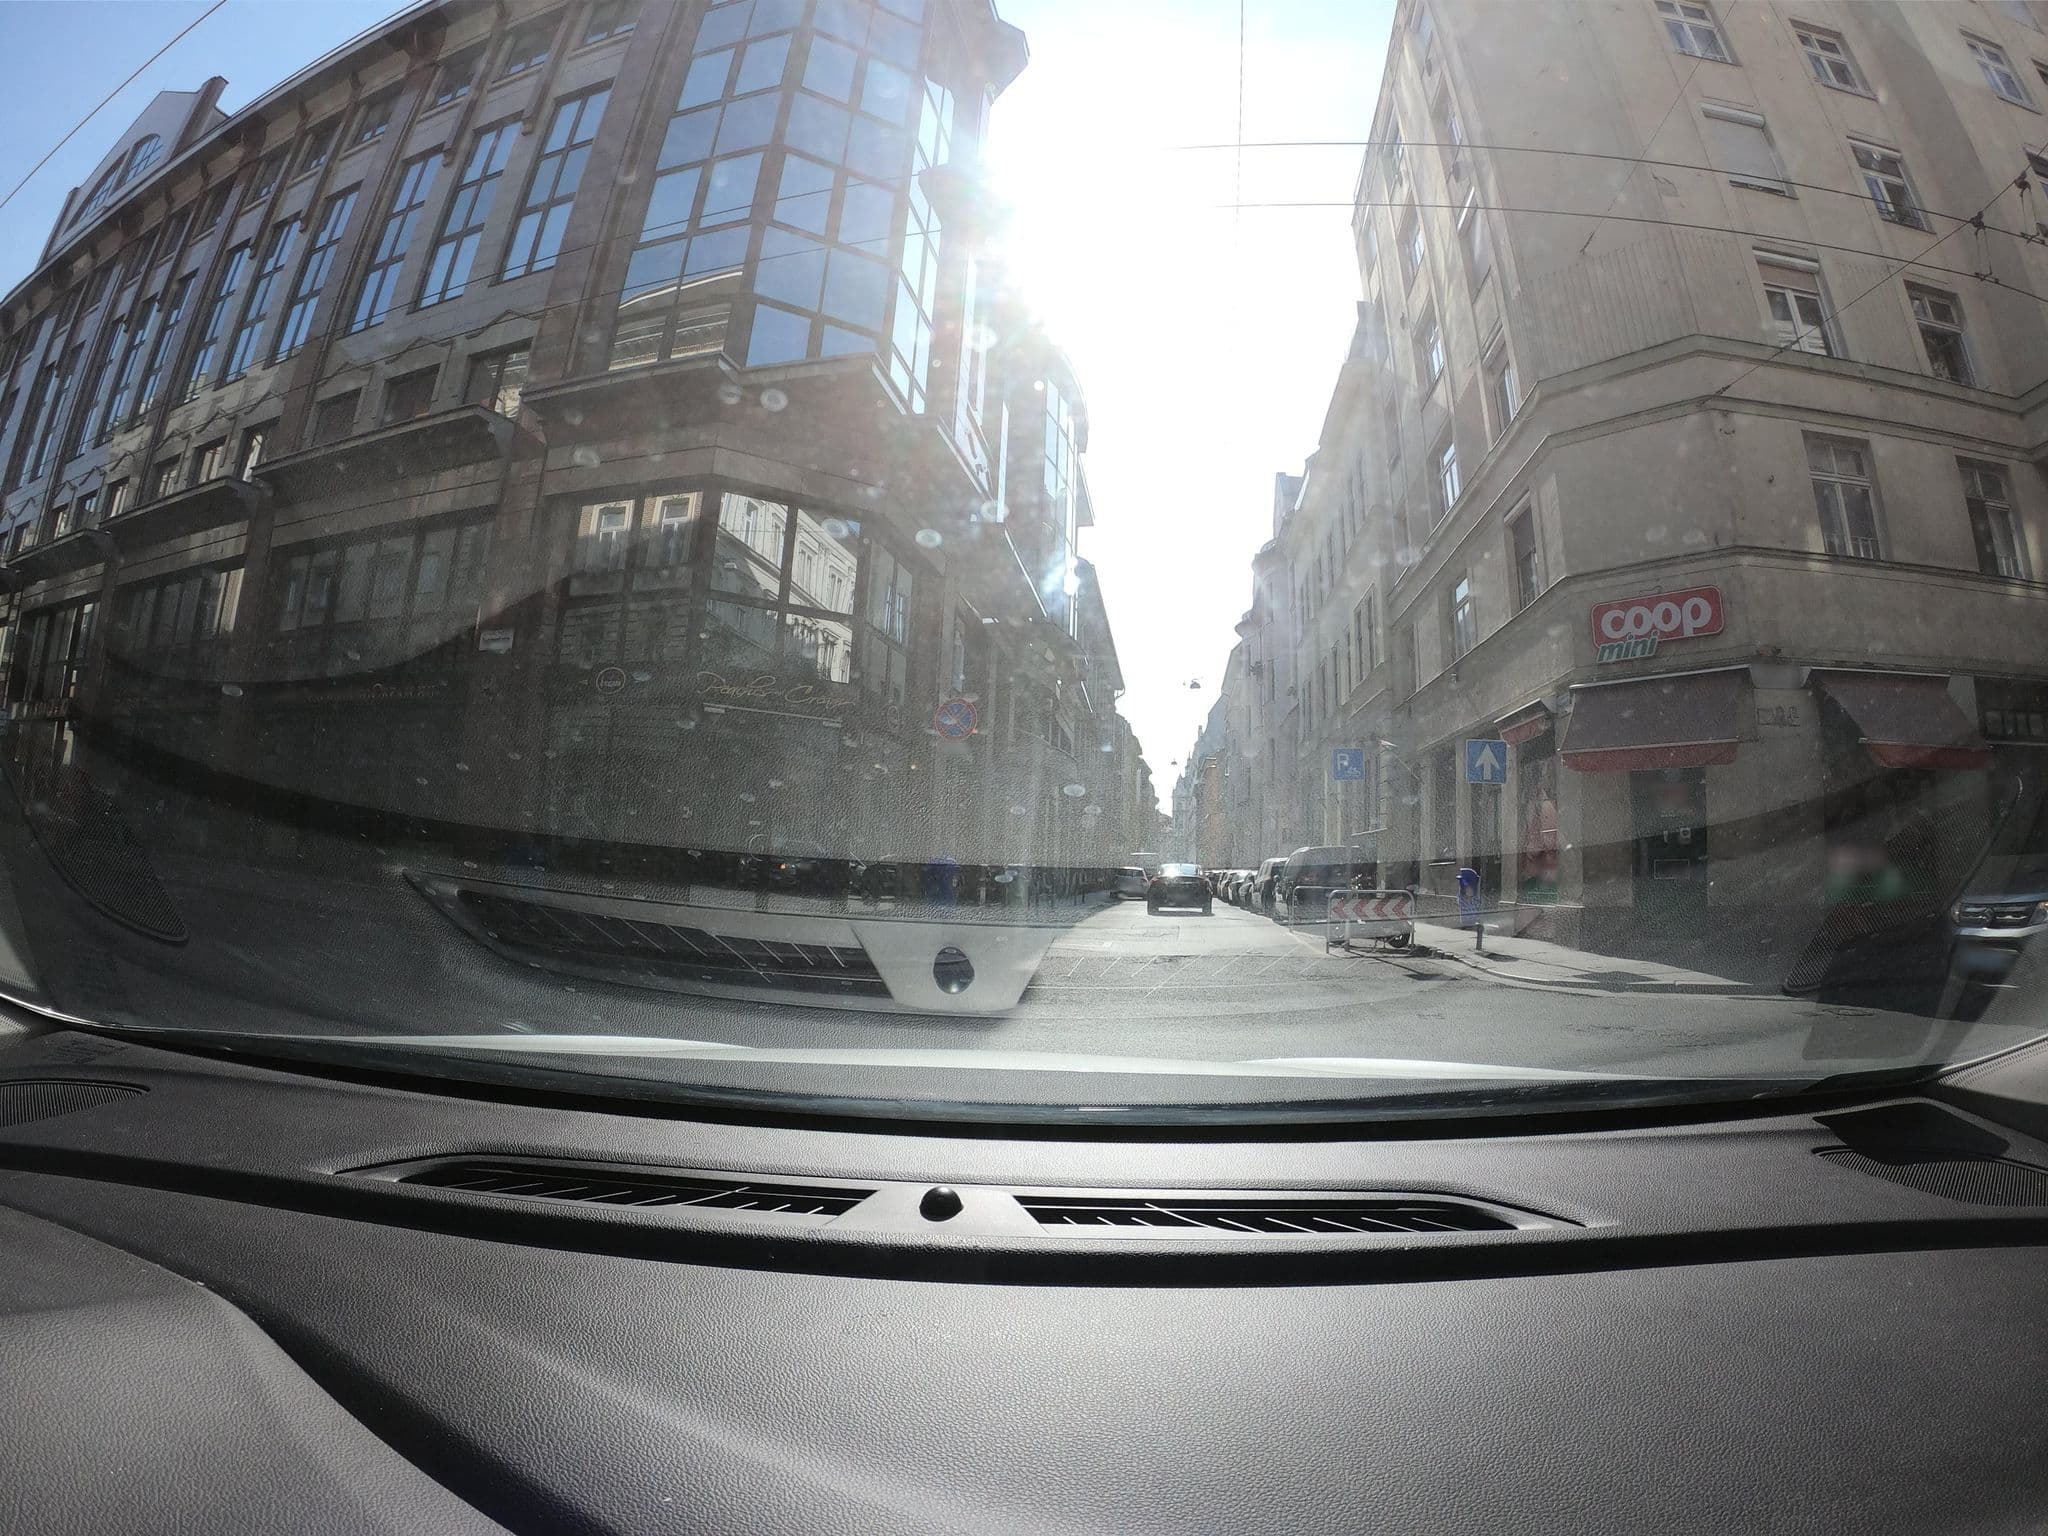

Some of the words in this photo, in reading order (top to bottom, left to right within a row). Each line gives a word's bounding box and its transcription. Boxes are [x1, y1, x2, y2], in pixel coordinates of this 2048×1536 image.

[1601, 597, 1712, 639] coop
[1597, 630, 1660, 663] mini
[1337, 753, 1350, 772] P
